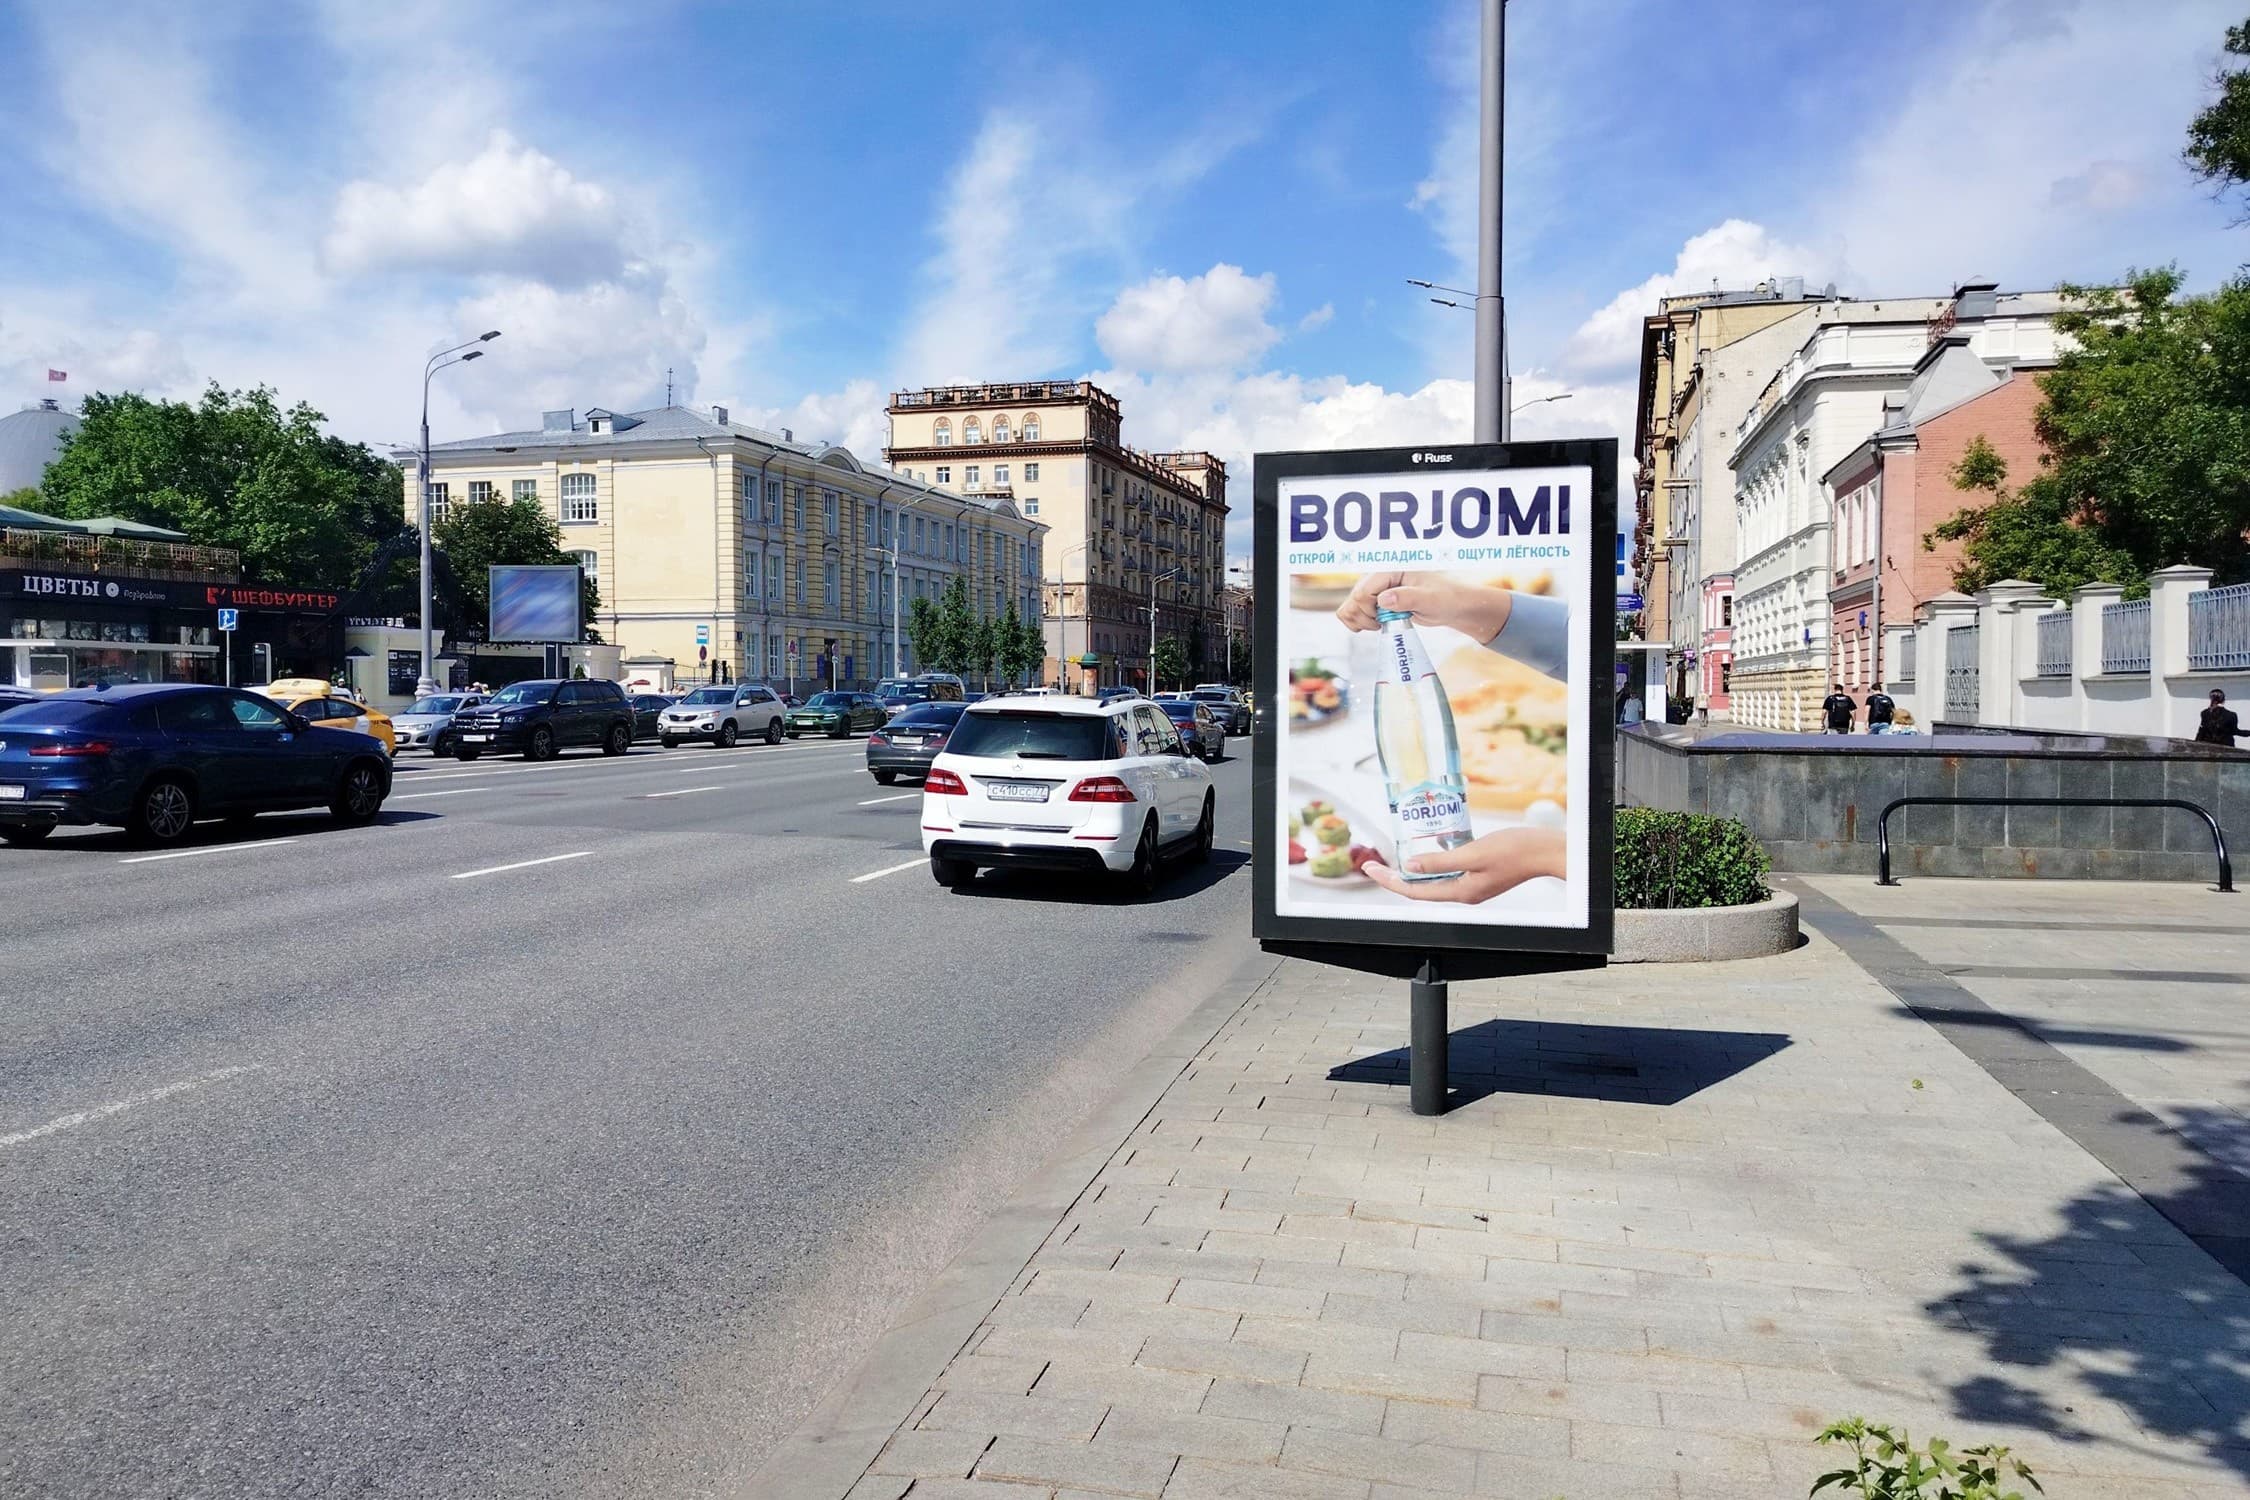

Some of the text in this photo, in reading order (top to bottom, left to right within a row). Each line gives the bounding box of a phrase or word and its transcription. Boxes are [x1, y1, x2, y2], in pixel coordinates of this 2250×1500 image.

[1424, 453, 1453, 463] Russ
[1290, 485, 1570, 543] BORJOMI
[1289, 545, 1570, 564] ОТКРОЙ НАСЛАДИСЬ ОЩУТИ ЛЁГКОСТЬ
[23, 576, 99, 597] ЦВЕТЫ
[232, 590, 338, 609] ШЕФБУРГЕР
[1393, 634, 1412, 682] BORJOMI
[1402, 801, 1462, 821] BORJOMI
